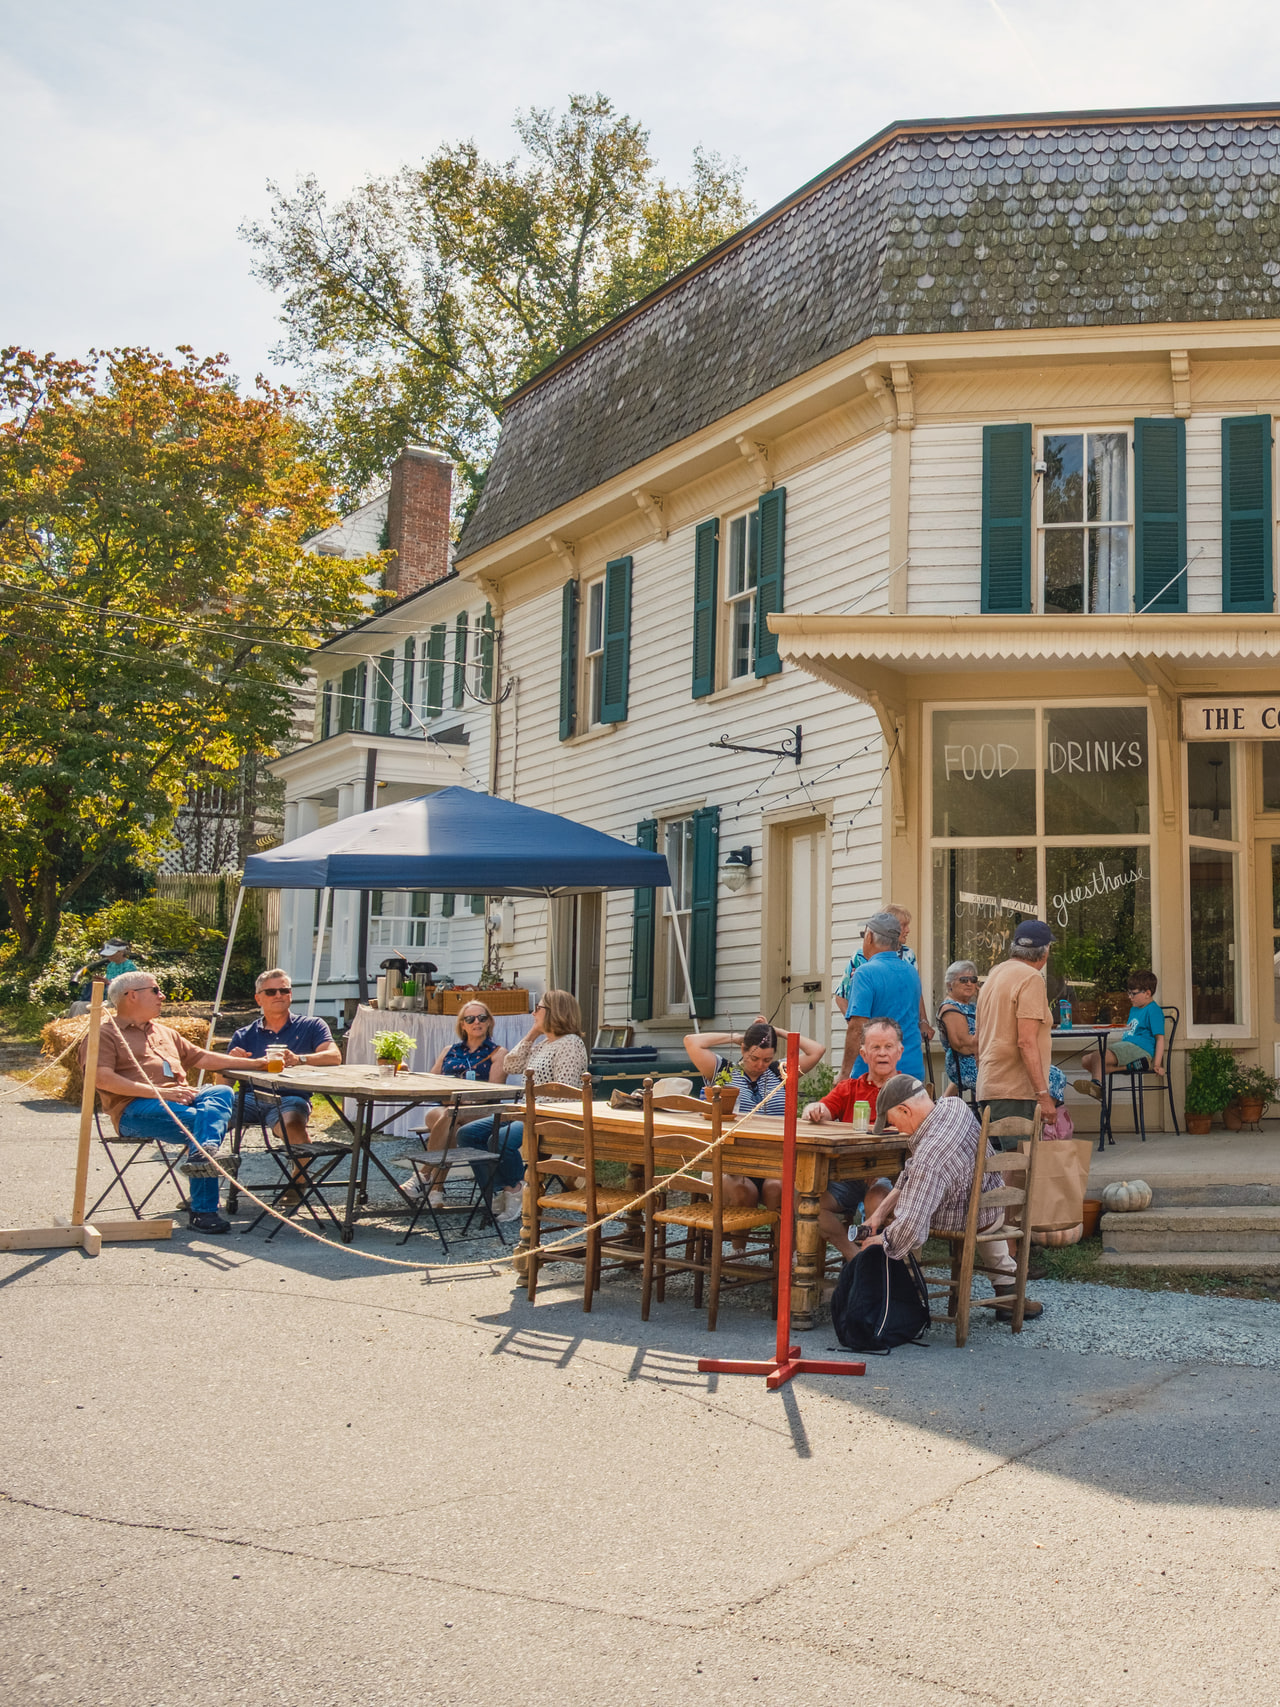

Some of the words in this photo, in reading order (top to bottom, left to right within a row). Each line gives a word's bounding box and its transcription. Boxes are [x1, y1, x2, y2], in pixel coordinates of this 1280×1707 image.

[1202, 707, 1246, 731] THE
[944, 743, 1019, 781] FOOD
[1050, 741, 1142, 774] DRINKS
[955, 902, 1015, 918] COMING
[1052, 861, 1150, 928] guesthouse
